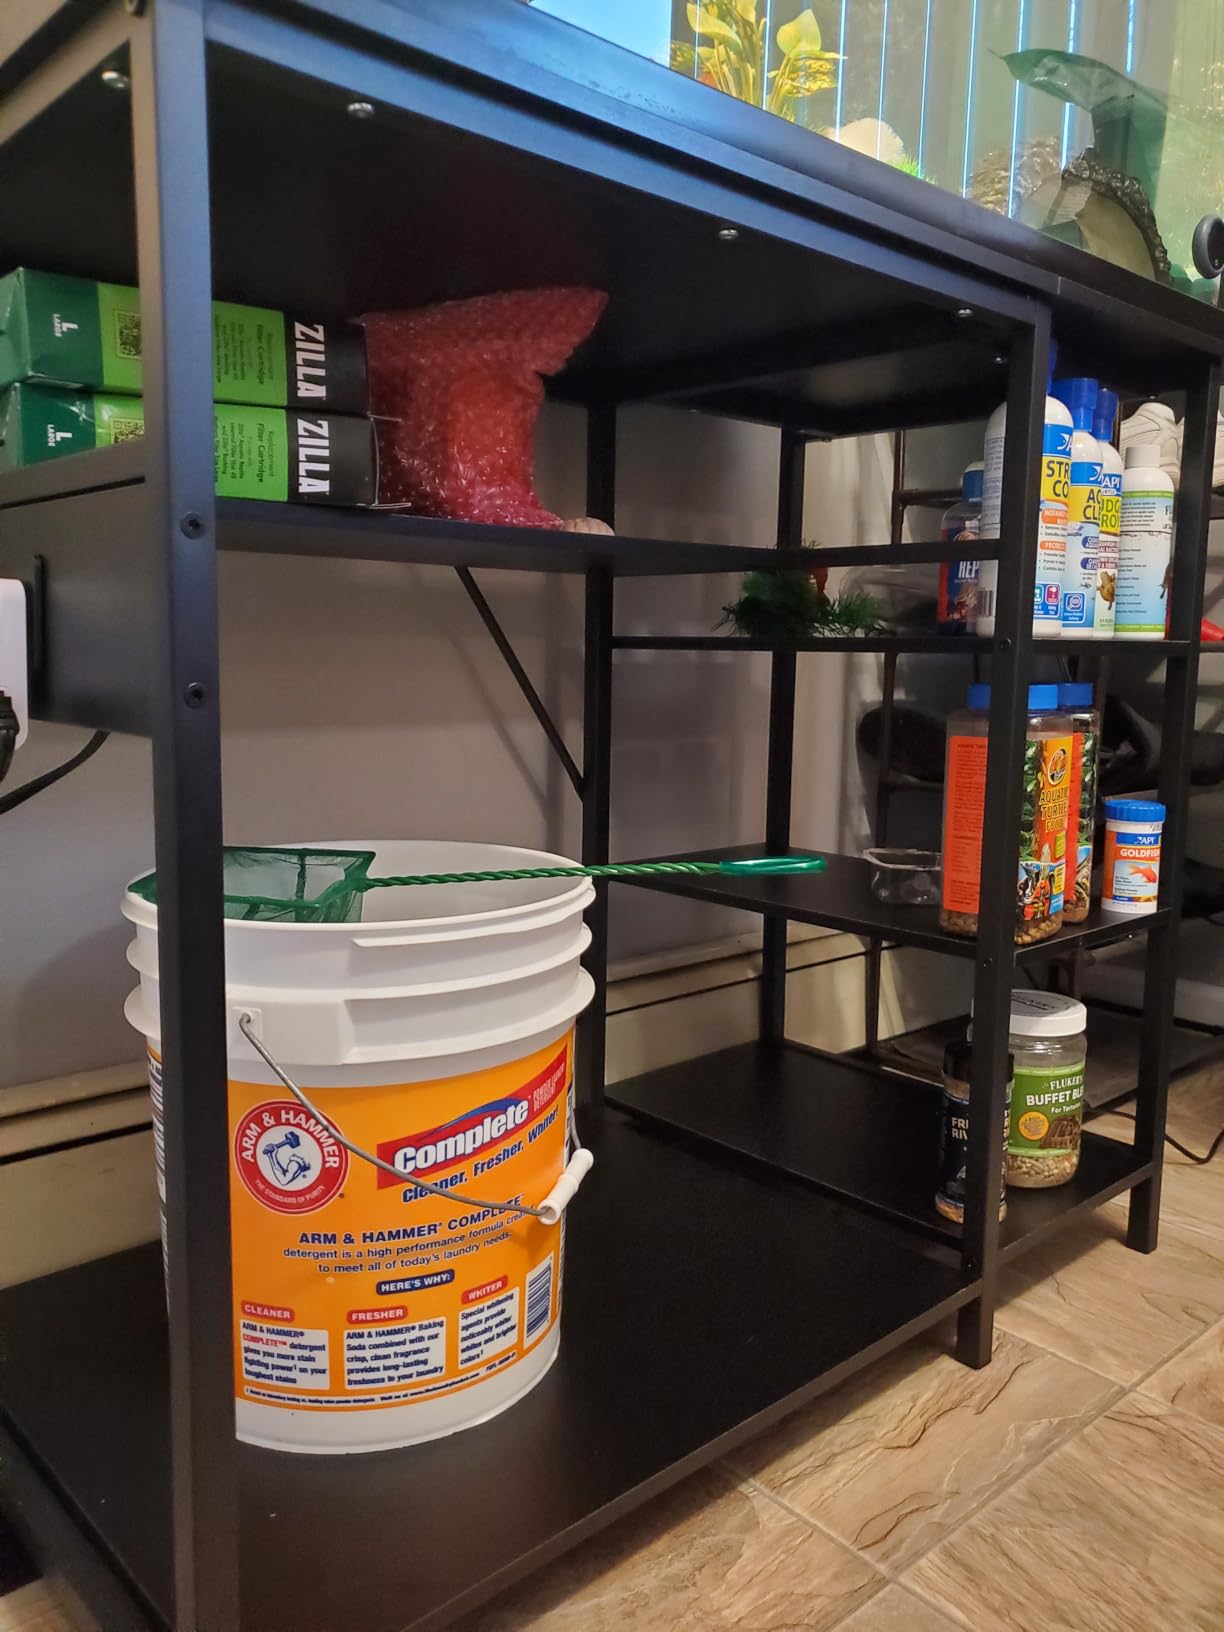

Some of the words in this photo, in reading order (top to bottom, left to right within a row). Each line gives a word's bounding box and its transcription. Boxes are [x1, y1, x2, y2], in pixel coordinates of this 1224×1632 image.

[294, 321, 326, 398] ZILLA
[297, 418, 330, 494] ZILLA
[256, 445, 265, 483] Cartridge
[1041, 803, 1068, 820] TURTLE
[1140, 837, 1154, 845] API
[1026, 1091, 1071, 1106] BUFFET
[242, 1122, 262, 1163] ARM
[262, 1112, 277, 1127] &
[281, 1110, 339, 1168] HAMMER
[394, 1100, 529, 1175] Complete
[255, 1179, 265, 1190] THE
[283, 1248, 337, 1260] detergent
[342, 1248, 351, 1258] is
[356, 1250, 363, 1258] a
[367, 1246, 392, 1259] high
[396, 1233, 465, 1256] performance
[469, 1221, 504, 1239] formula
[300, 1232, 337, 1245] ARM
[343, 1233, 355, 1244] &
[318, 1264, 330, 1273] to
[334, 1263, 363, 1273] meet
[367, 1261, 381, 1271] all
[385, 1260, 397, 1270] of
[400, 1252, 440, 1269] today's
[444, 1242, 480, 1260] laundry
[483, 1232, 512, 1247] needs.
[381, 1278, 421, 1292] HERE'S
[468, 1280, 502, 1300] WHITER
[244, 1304, 291, 1319] CLEANER
[351, 1309, 404, 1320] FRESHER
[461, 1306, 485, 1320] Special
[484, 1308, 506, 1324] provide
[242, 1321, 258, 1332] ARM
[346, 1332, 365, 1340] ARM
[418, 1320, 444, 1331] Baking
[346, 1343, 366, 1351] Soda
[368, 1338, 406, 1350] combined
[409, 1335, 425, 1344] with
[427, 1332, 440, 1341] our
[483, 1334, 495, 1345] and
[289, 1343, 326, 1352] detergent
[347, 1354, 369, 1363] crisp,
[370, 1352, 391, 1361] clean
[393, 1347, 430, 1358] fragrance
[262, 1350, 275, 1358] you
[297, 1354, 316, 1362] stain
[347, 1365, 380, 1376] provides
[387, 1374, 395, 1382] to
[397, 1372, 414, 1382] your
